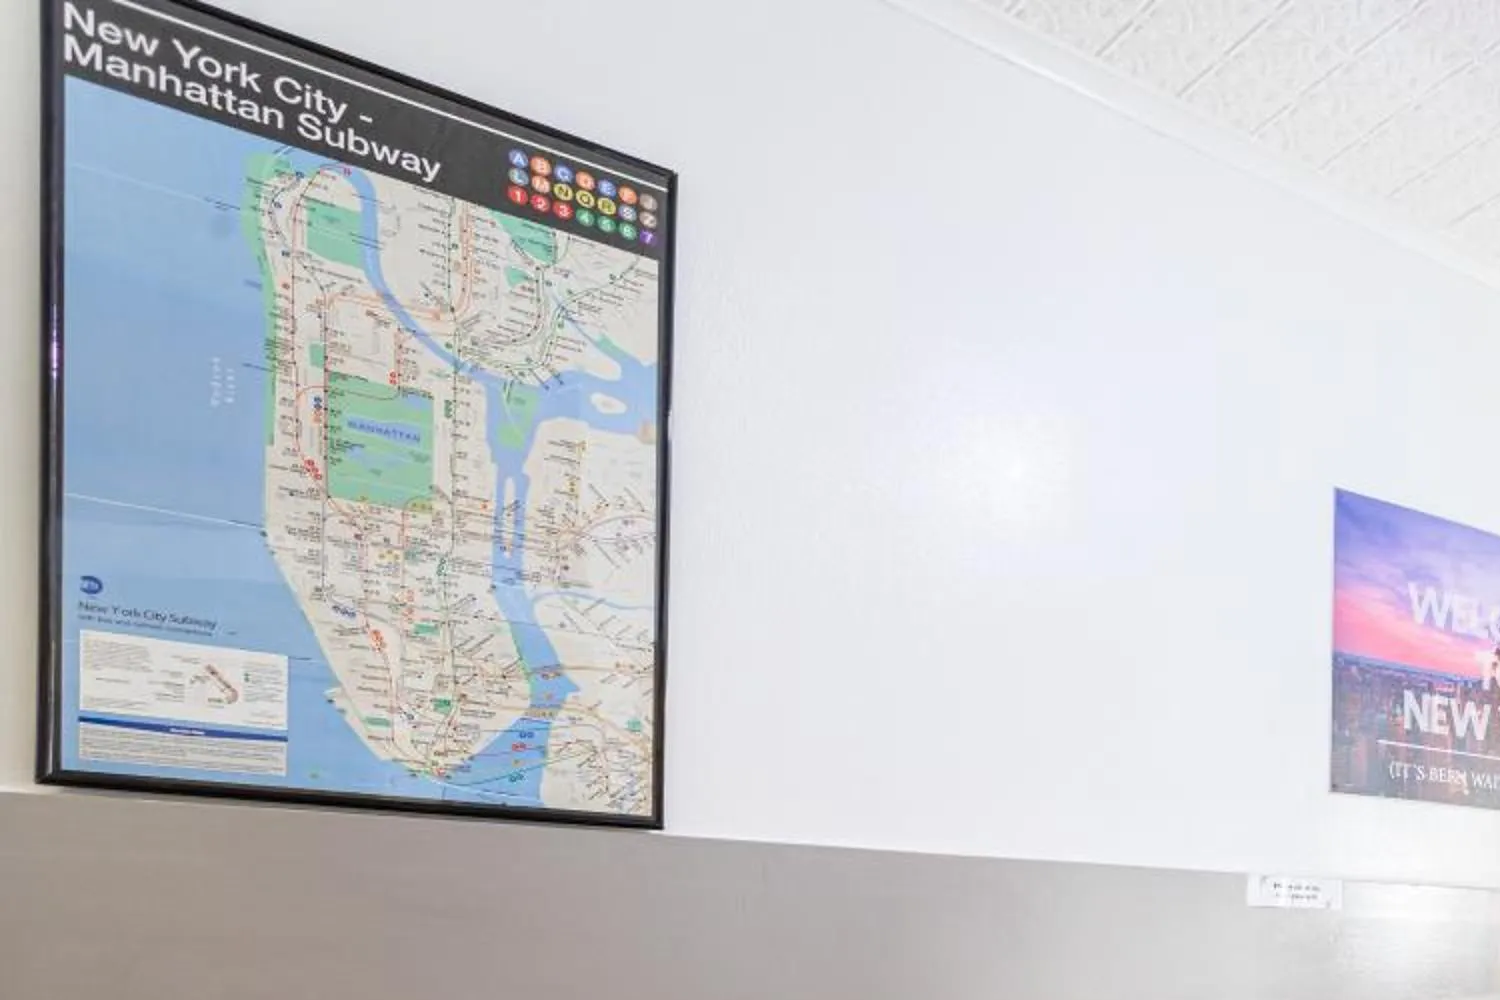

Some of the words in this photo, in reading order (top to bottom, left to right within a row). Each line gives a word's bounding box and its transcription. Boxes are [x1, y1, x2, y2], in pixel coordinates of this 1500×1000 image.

[64, 1, 159, 57] New
[172, 38, 262, 93] York
[274, 76, 348, 124] City
[64, 33, 285, 130] Manhattan
[297, 113, 441, 183] Subway
[143, 609, 167, 622] City
[1403, 689, 1491, 741] NEW
[1429, 767, 1467, 786] BEEN
